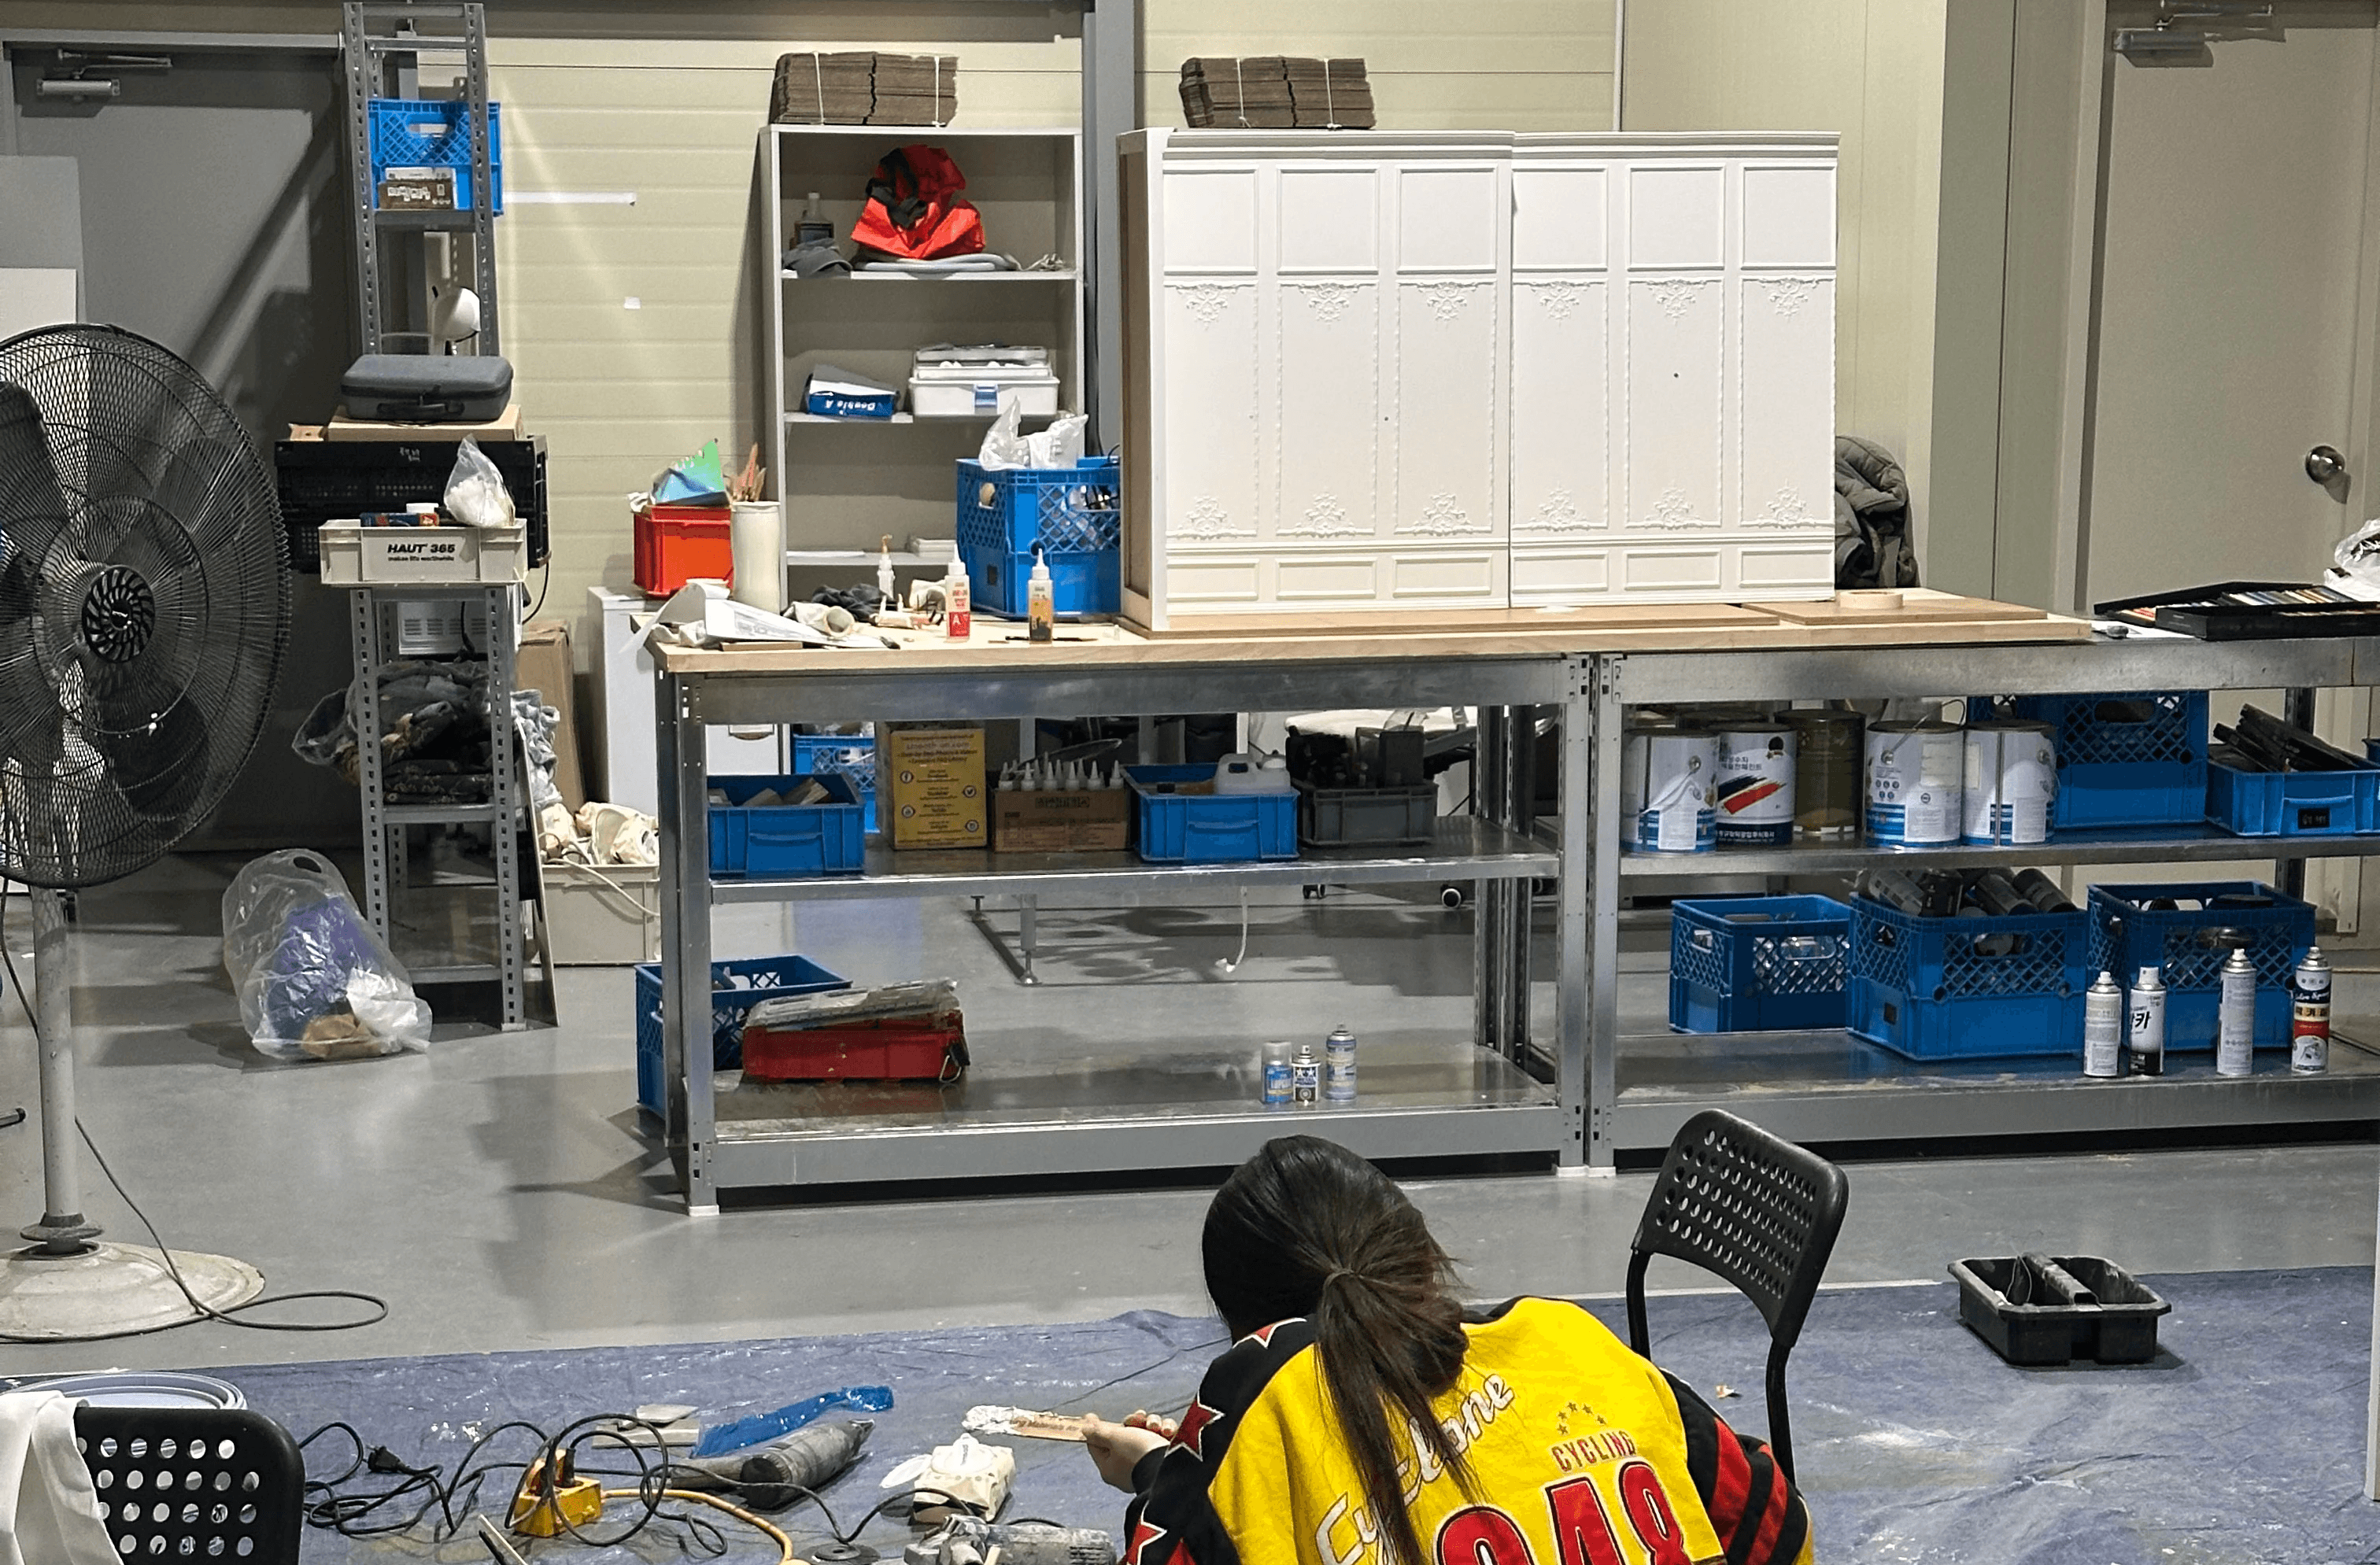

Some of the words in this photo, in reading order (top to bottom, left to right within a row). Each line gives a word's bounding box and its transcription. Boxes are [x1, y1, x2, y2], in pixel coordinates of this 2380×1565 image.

[824, 400, 834, 408] A
[836, 400, 876, 412] Double
[387, 544, 427, 554] HAUT
[430, 544, 456, 554] 365
[1551, 1430, 1636, 1473] CYCLING
